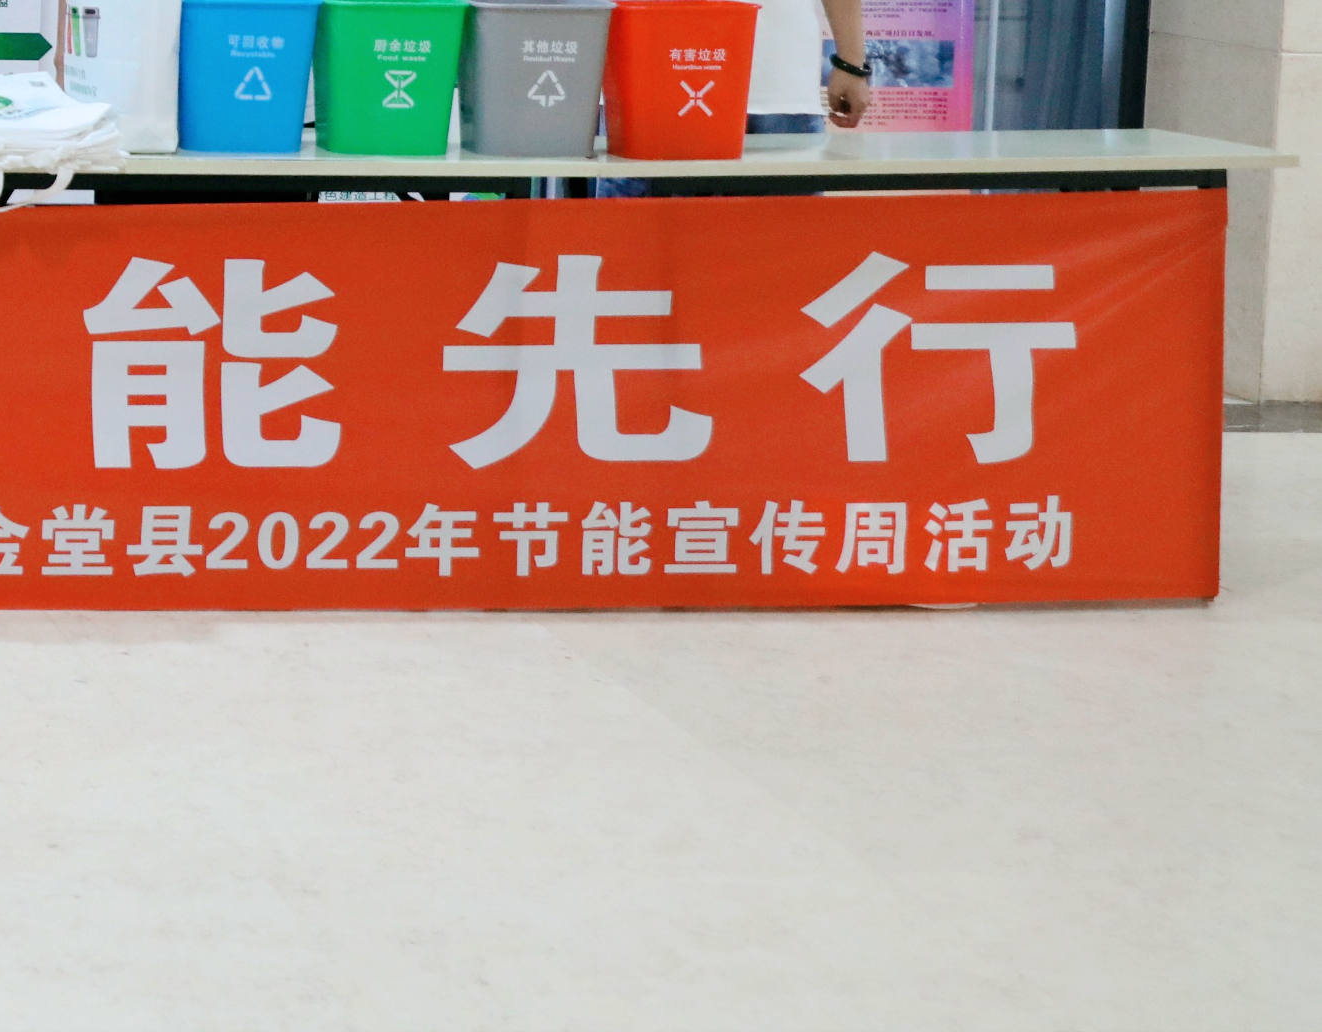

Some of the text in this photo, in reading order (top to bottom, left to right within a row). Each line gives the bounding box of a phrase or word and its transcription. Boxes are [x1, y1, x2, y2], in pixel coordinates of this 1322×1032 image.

[228, 34, 285, 50] 可回收物
[374, 39, 432, 53] 厨余垃圾
[522, 40, 578, 55] 其他垃圾
[669, 48, 727, 61] 有害垃圾
